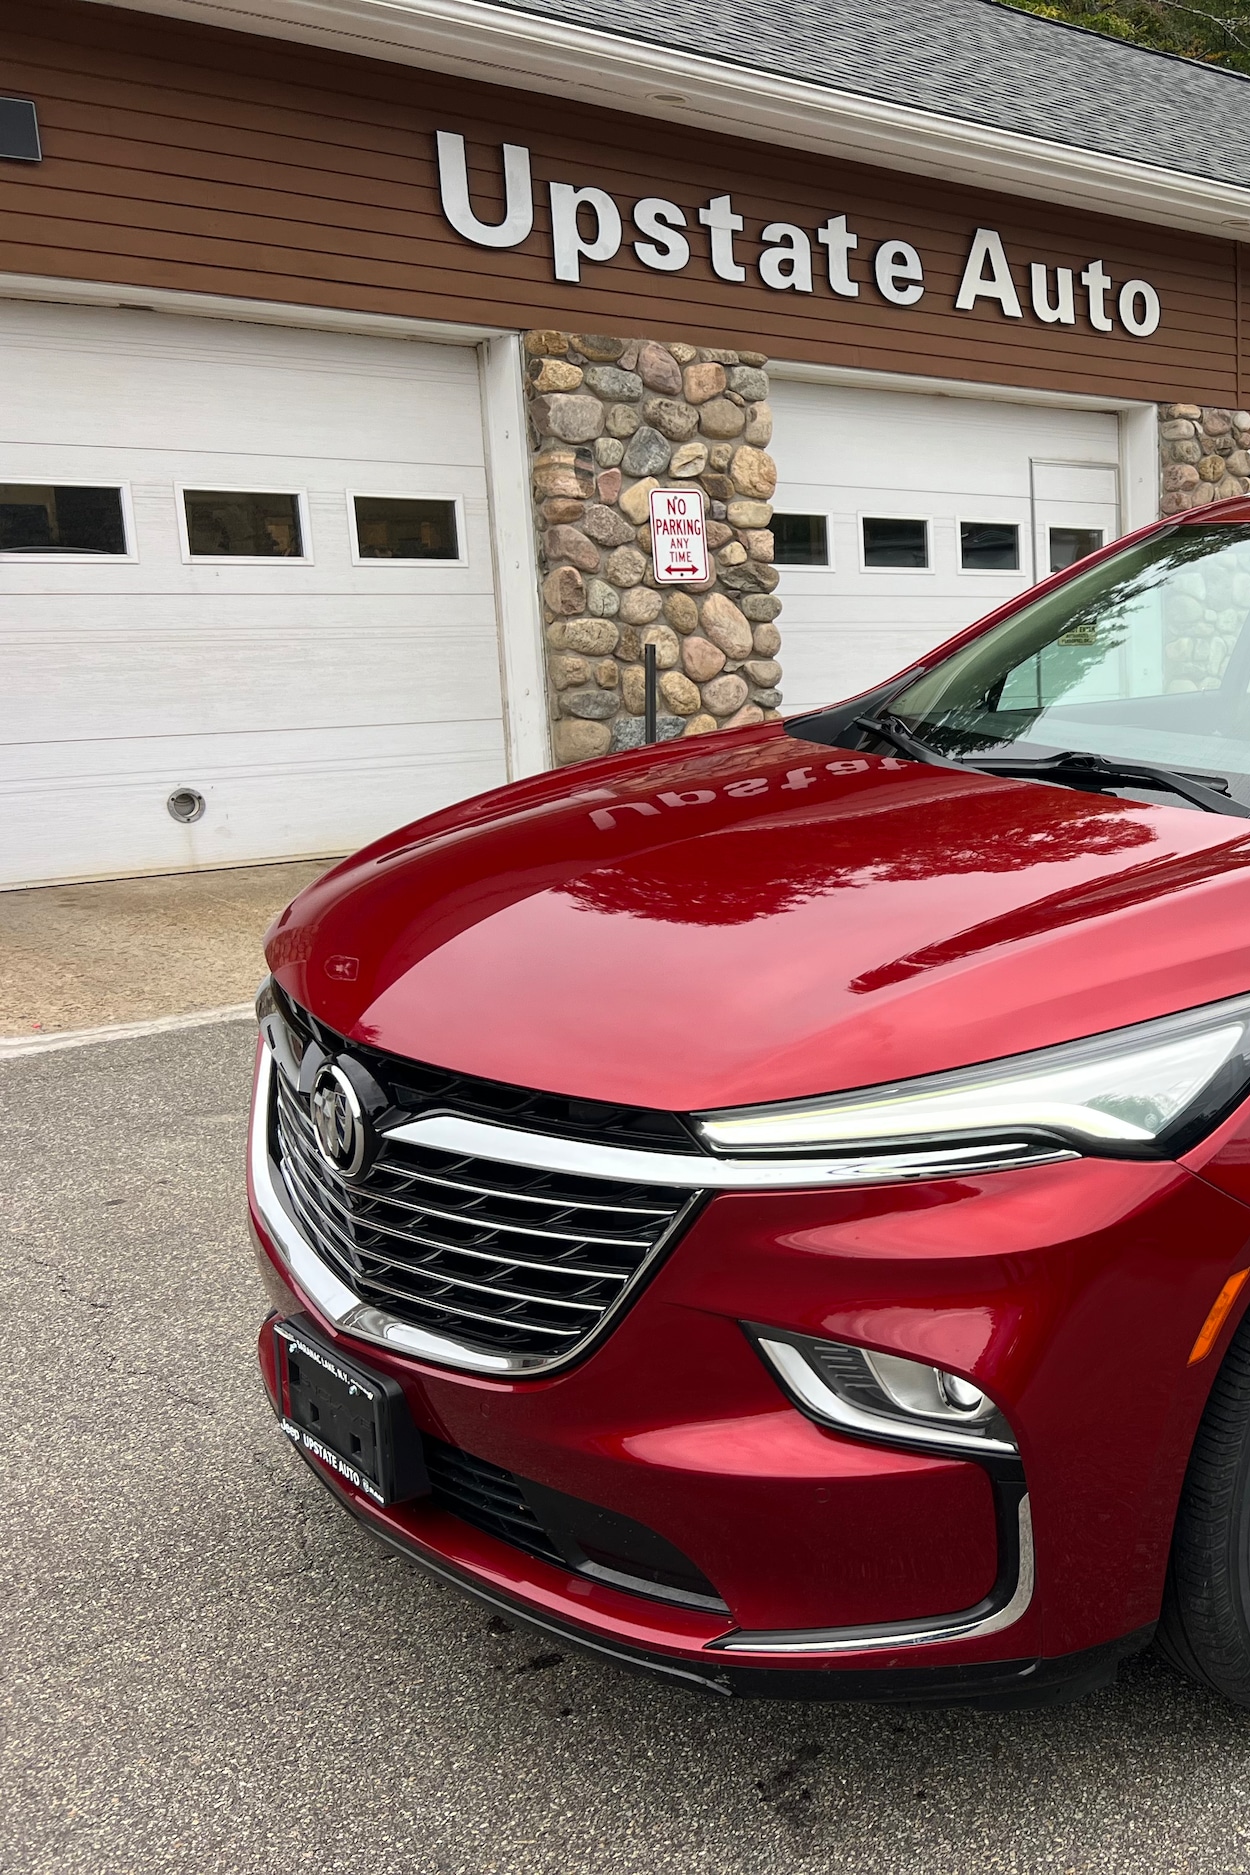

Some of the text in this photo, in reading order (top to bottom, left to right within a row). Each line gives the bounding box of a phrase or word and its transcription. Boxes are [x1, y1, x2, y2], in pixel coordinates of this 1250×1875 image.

[434, 129, 1161, 338] Upstate Auto
[667, 498, 687, 515] NO
[655, 518, 701, 536] PARKING
[670, 538, 689, 549] ANY
[669, 551, 692, 563] TIME
[280, 1417, 300, 1441] Jeep
[303, 1432, 338, 1469] UPSTATE
[338, 1459, 360, 1486] AUTO
